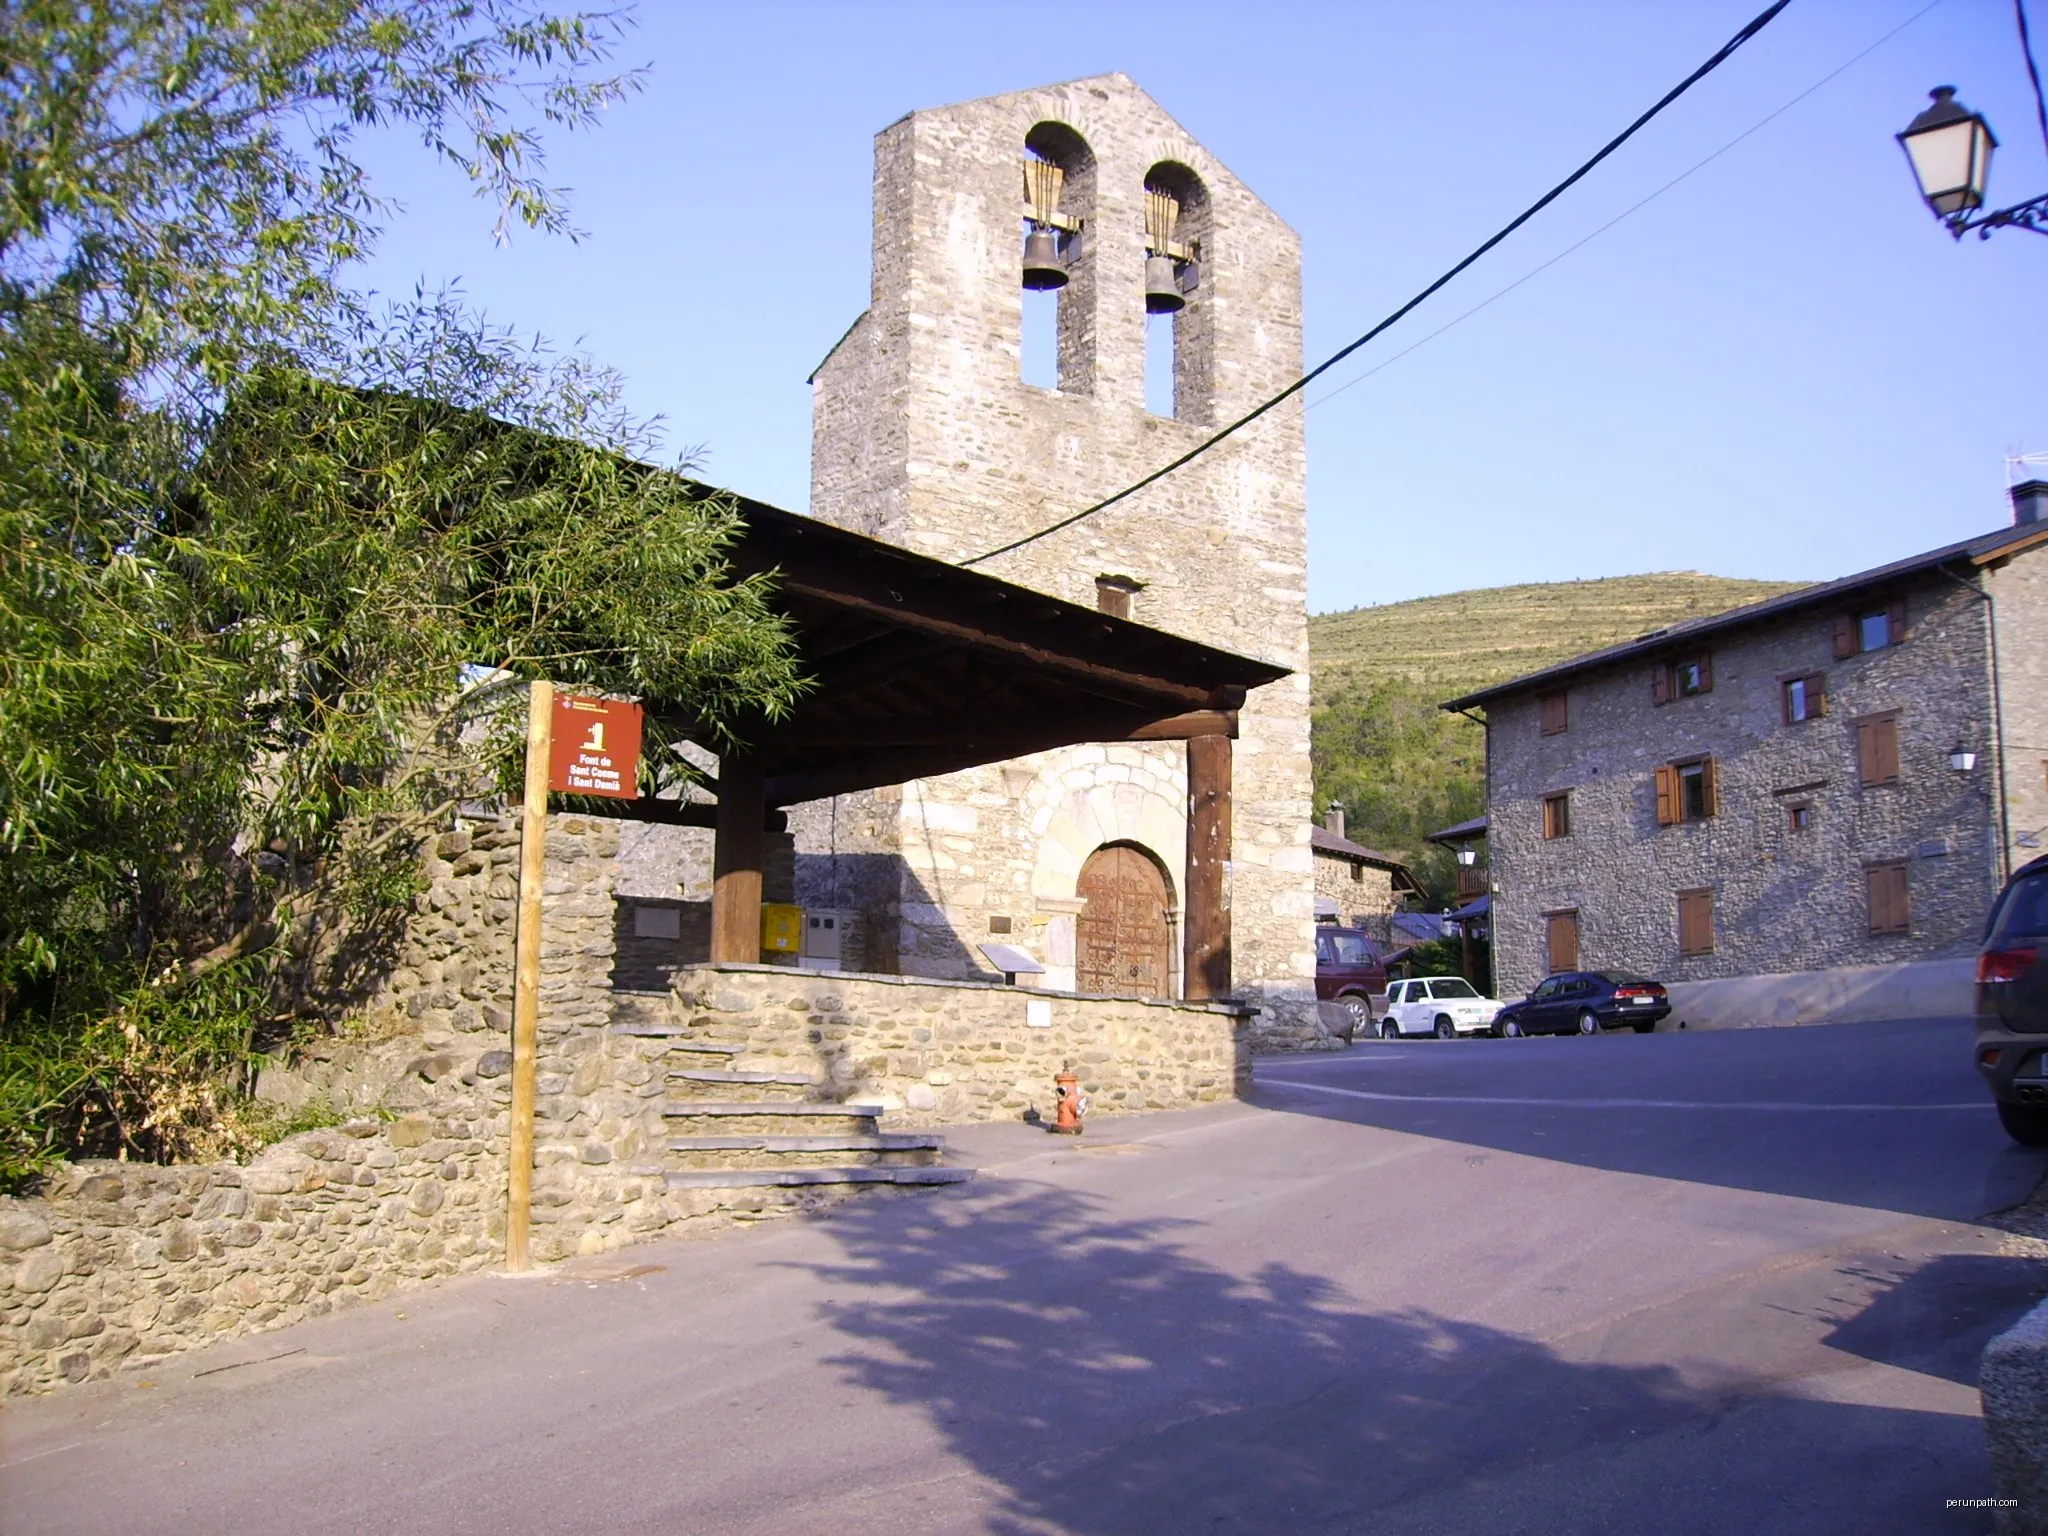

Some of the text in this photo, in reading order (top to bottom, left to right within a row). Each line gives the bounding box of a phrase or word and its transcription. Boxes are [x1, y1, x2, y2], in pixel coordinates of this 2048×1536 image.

[579, 753, 612, 767] Font de
[569, 764, 620, 779] Sant Cosme
[573, 776, 593, 788] Sant
